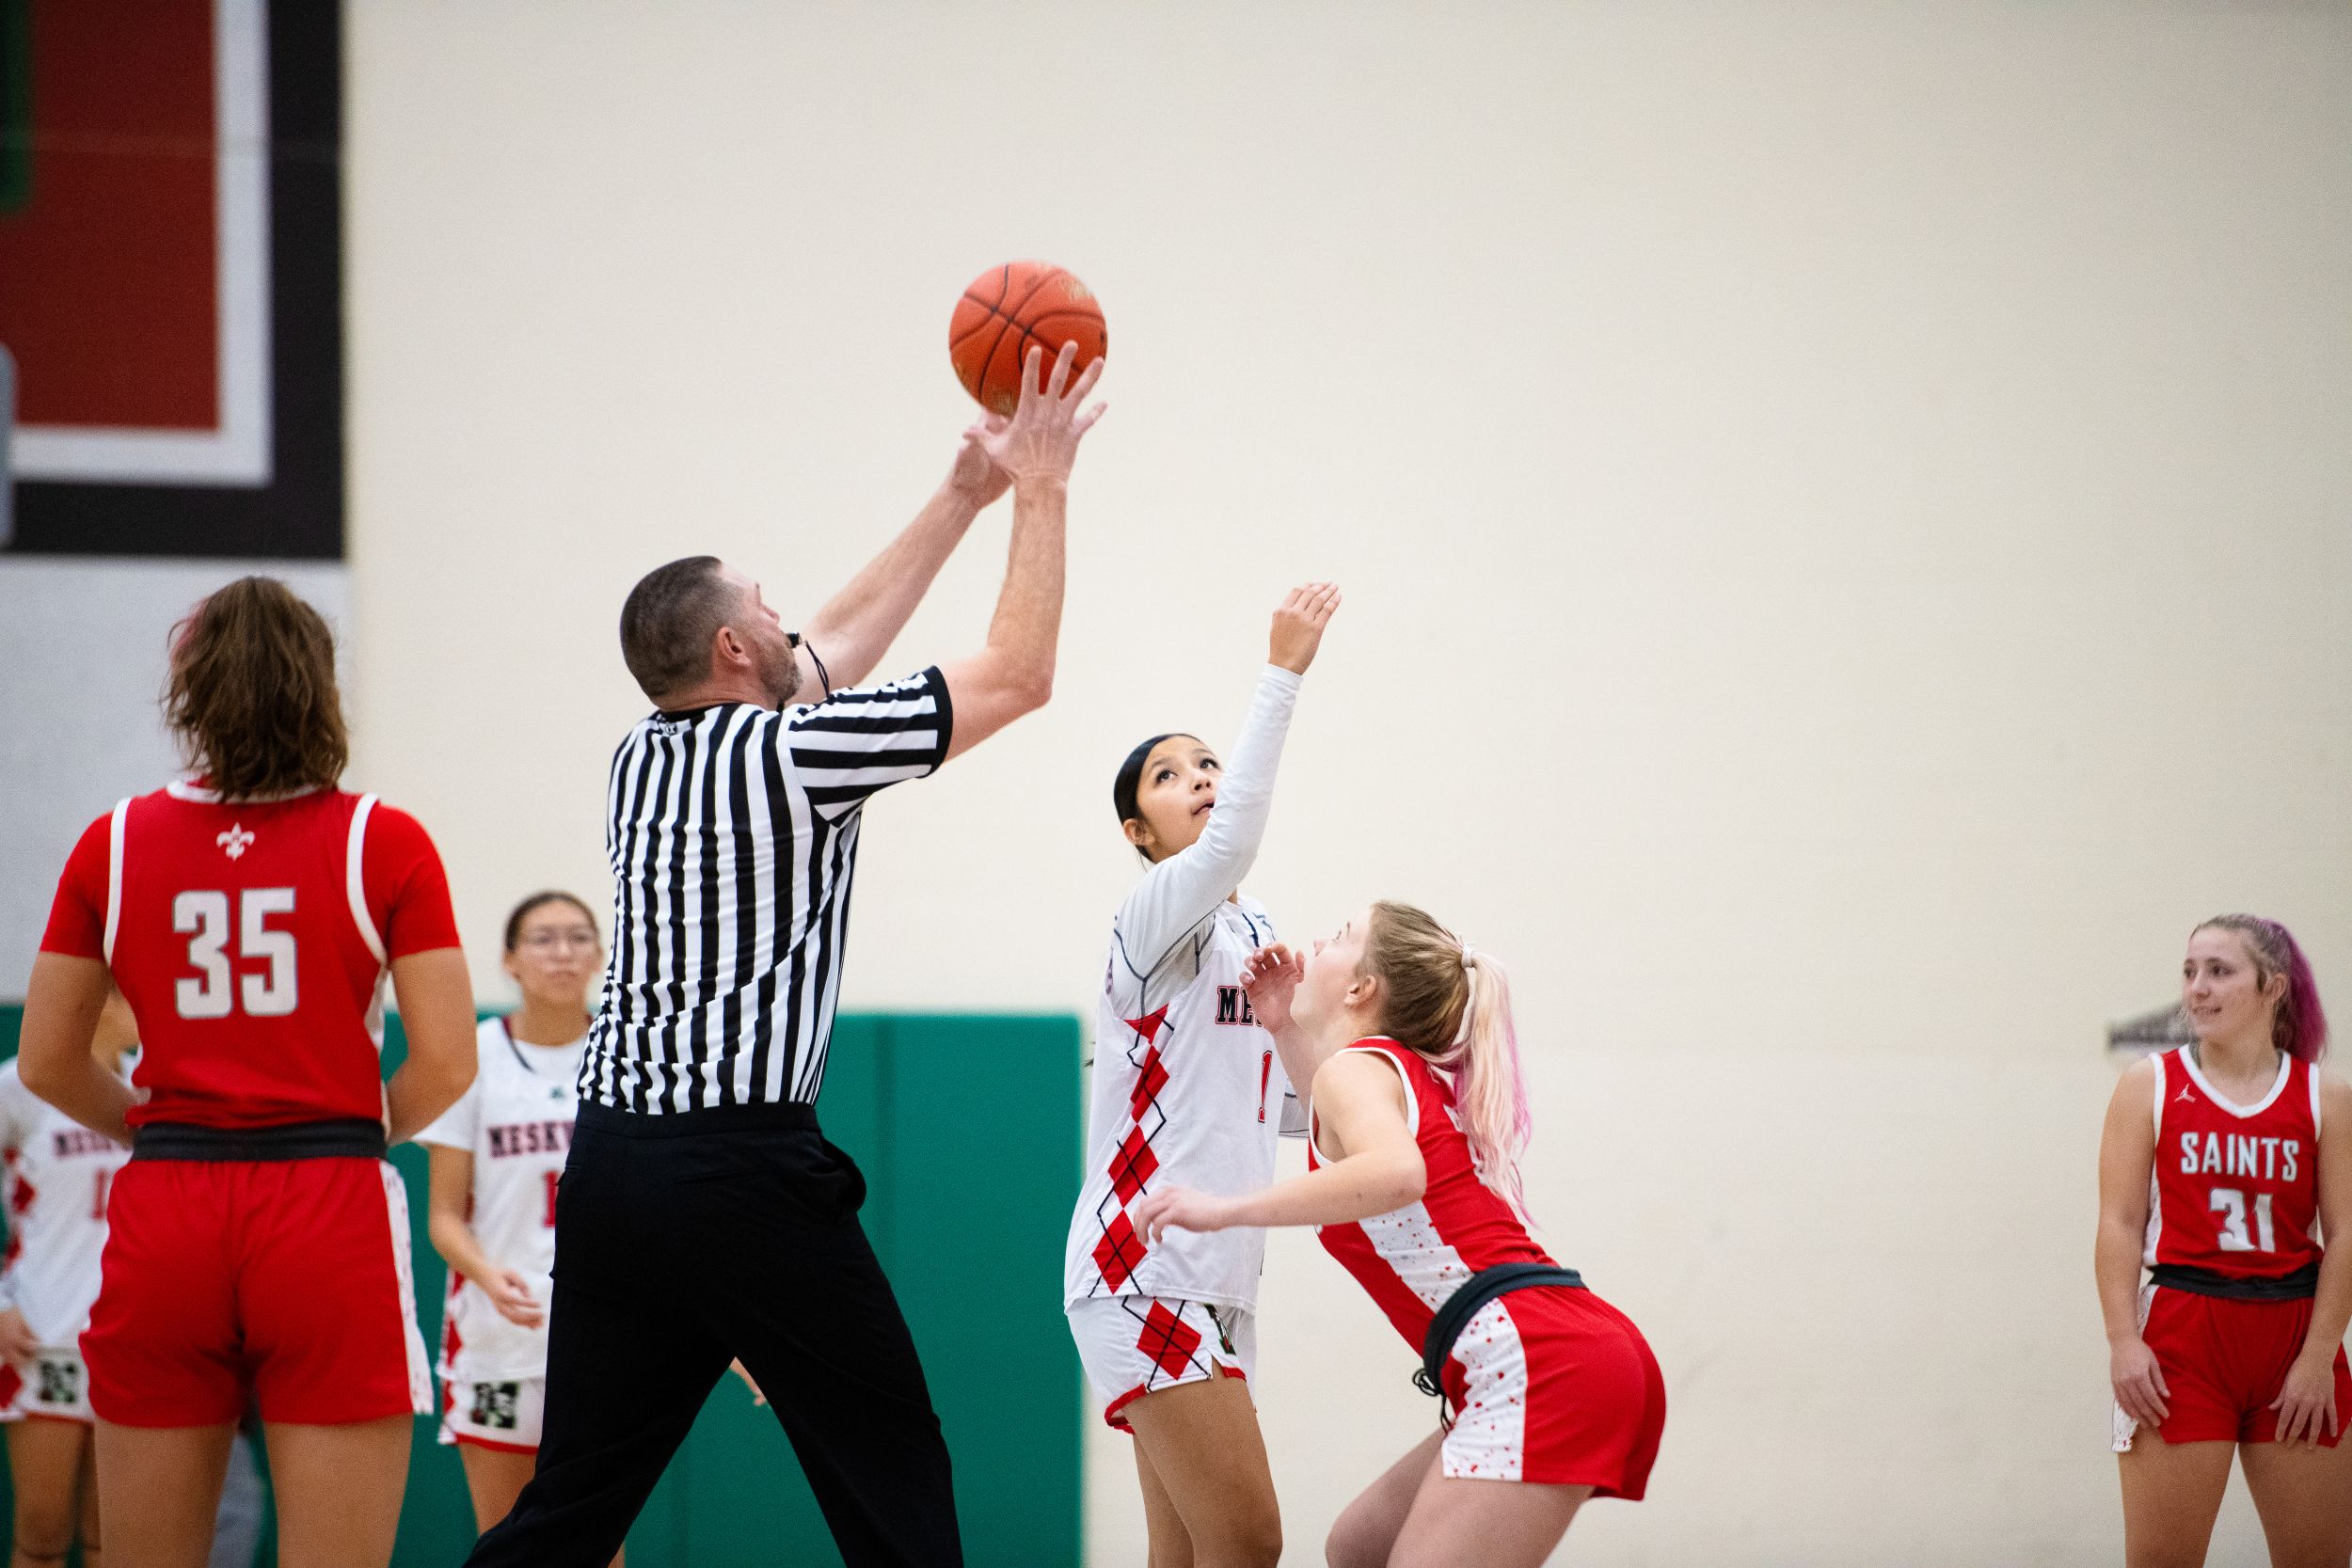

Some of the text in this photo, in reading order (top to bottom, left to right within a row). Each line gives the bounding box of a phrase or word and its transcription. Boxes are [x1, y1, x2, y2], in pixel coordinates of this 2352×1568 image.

[172, 887, 298, 1020] 35
[1216, 986, 1263, 1027] ME
[2181, 1131, 2299, 1183] SAINTS
[2209, 1187, 2276, 1254] 31
